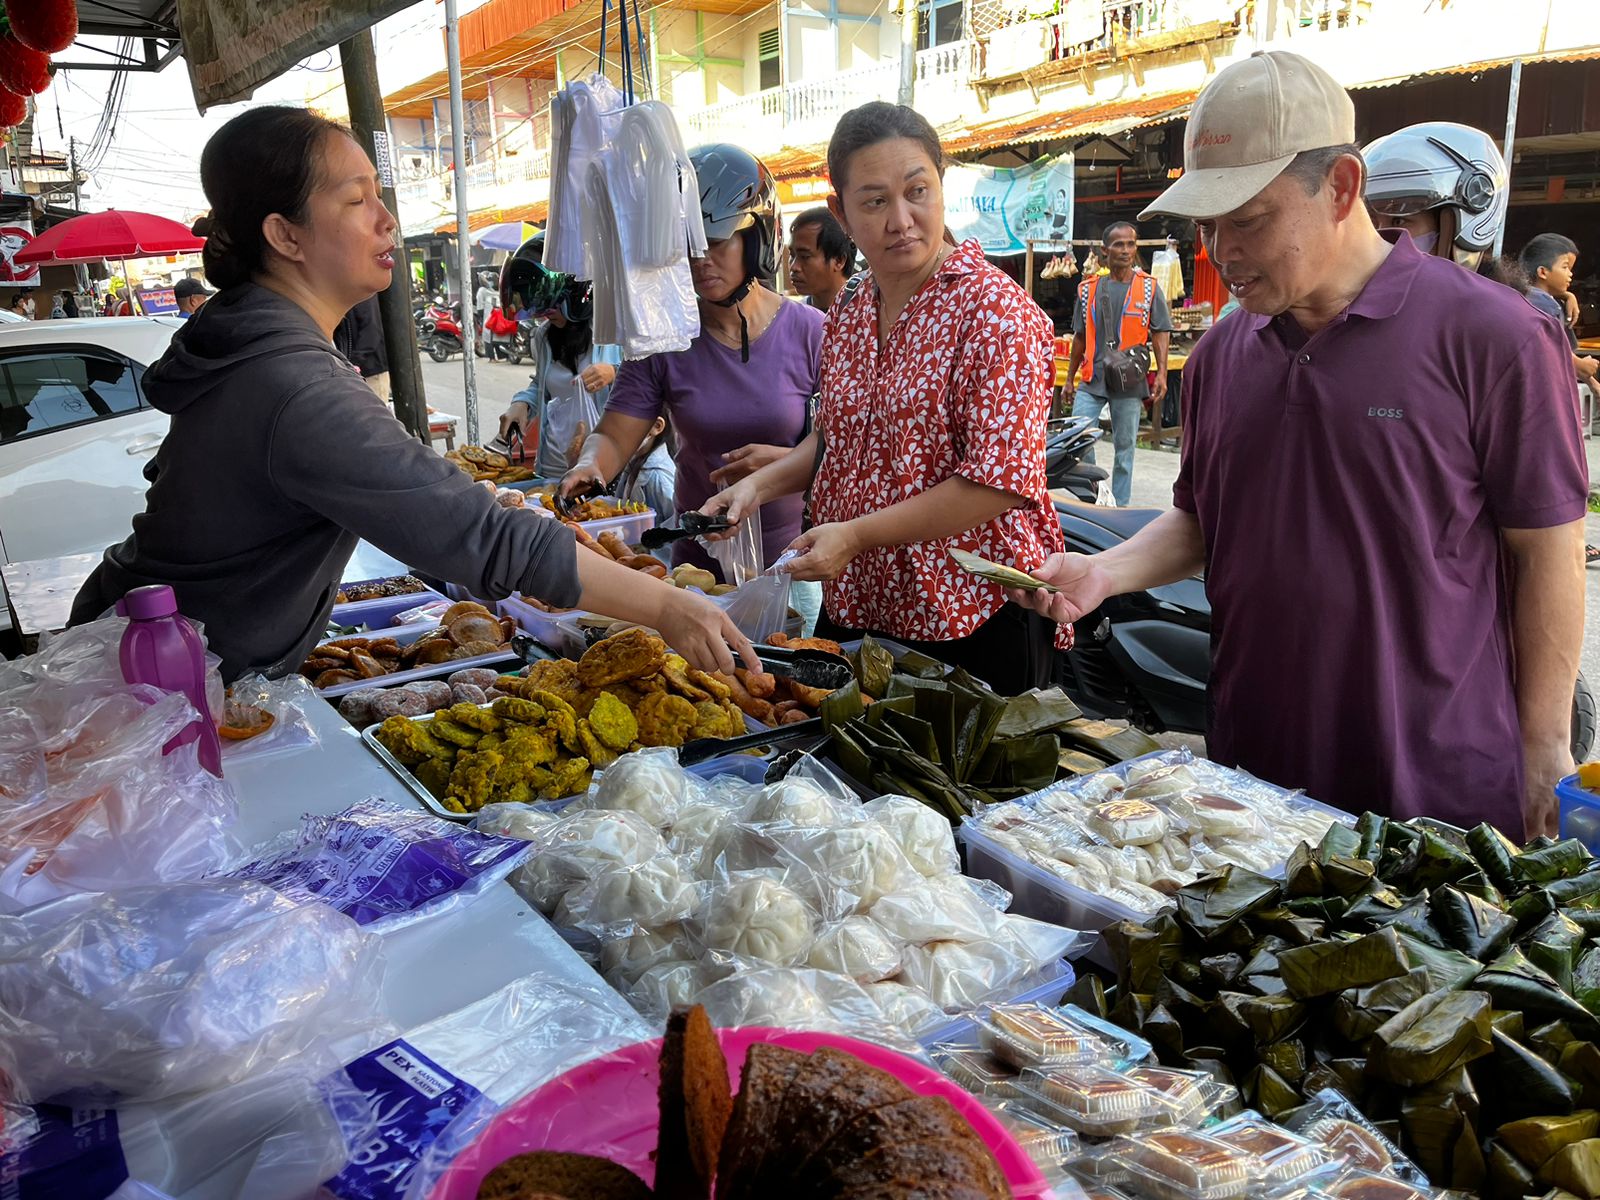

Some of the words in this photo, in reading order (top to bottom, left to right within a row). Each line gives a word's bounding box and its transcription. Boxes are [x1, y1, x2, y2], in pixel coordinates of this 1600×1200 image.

[1367, 407, 1404, 419] BOSS
[385, 1051, 415, 1073] PEX
[410, 1076, 437, 1095] PLASTIK
[416, 1069, 447, 1092] KANTONG
